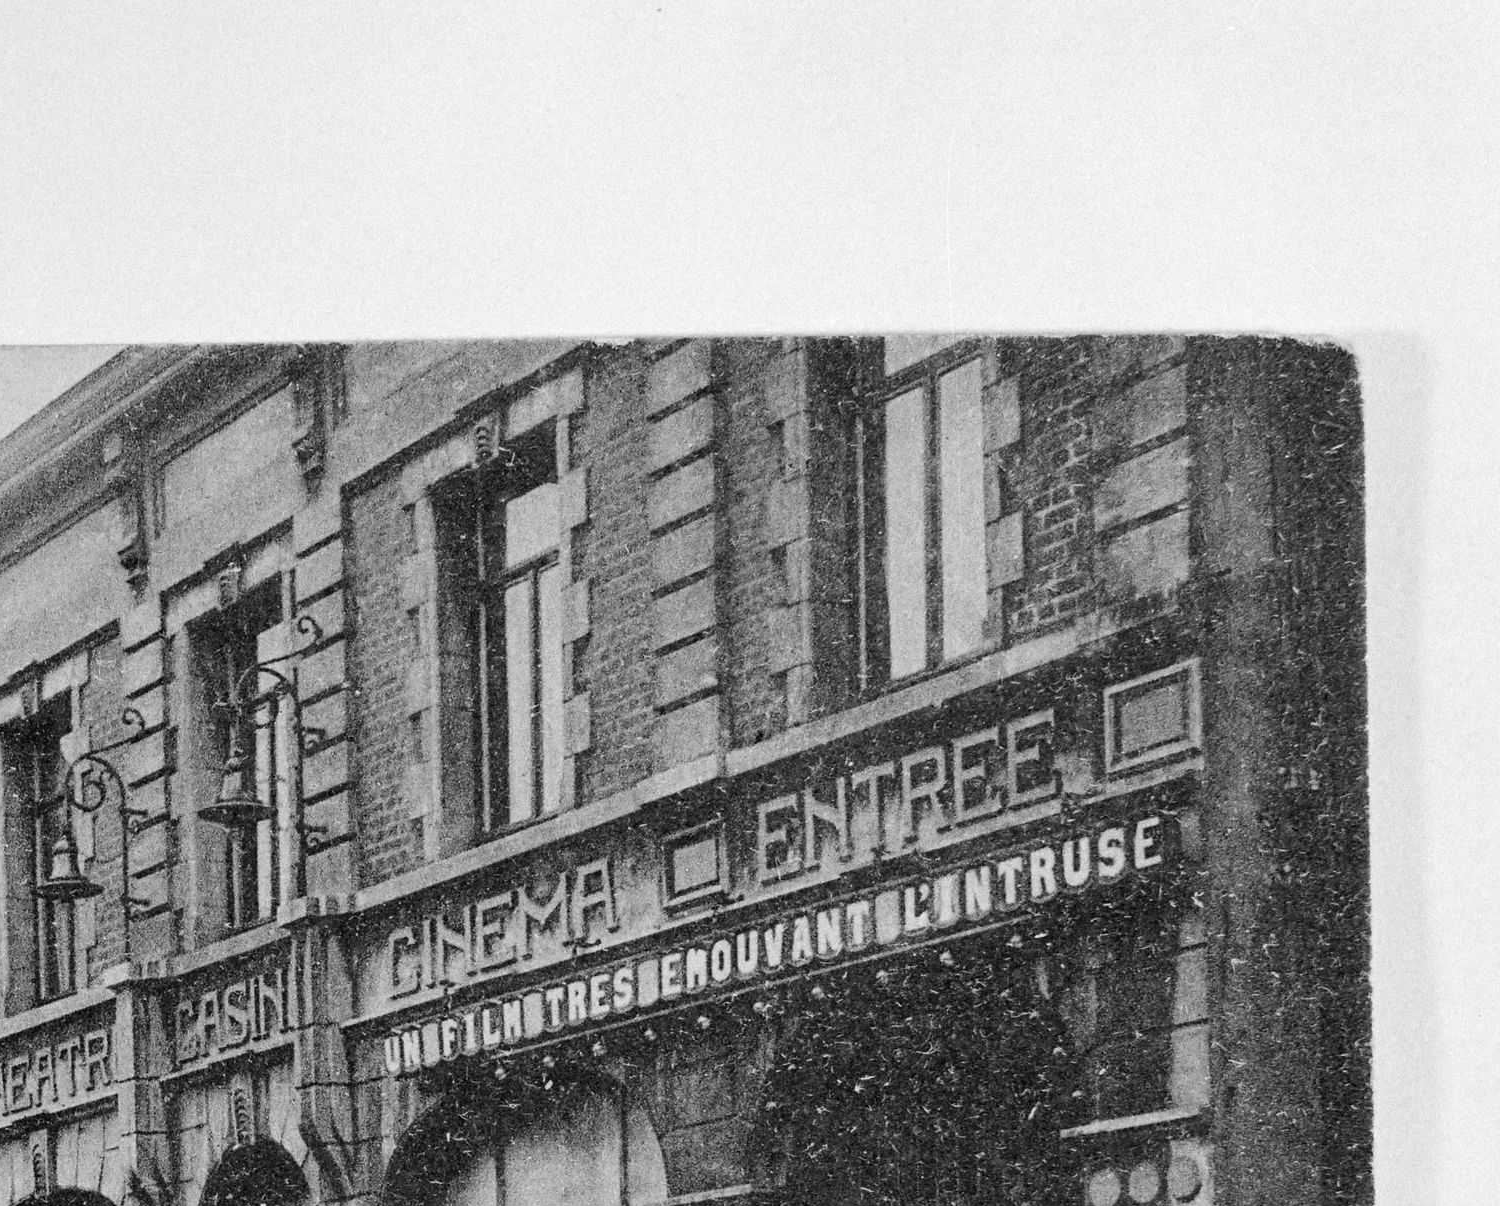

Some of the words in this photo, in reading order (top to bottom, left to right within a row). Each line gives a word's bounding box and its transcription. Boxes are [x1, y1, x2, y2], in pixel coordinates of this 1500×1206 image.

[756, 708, 1060, 885] ENTREE
[384, 1030, 421, 1074] UN
[441, 1000, 522, 1060] FILM
[546, 966, 635, 1029] TRES
[660, 901, 871, 998] EMOUVANT
[904, 816, 1163, 933] L'INTRUSE
[387, 858, 619, 1000] CINEMA
[177, 968, 283, 1064] CASIN
